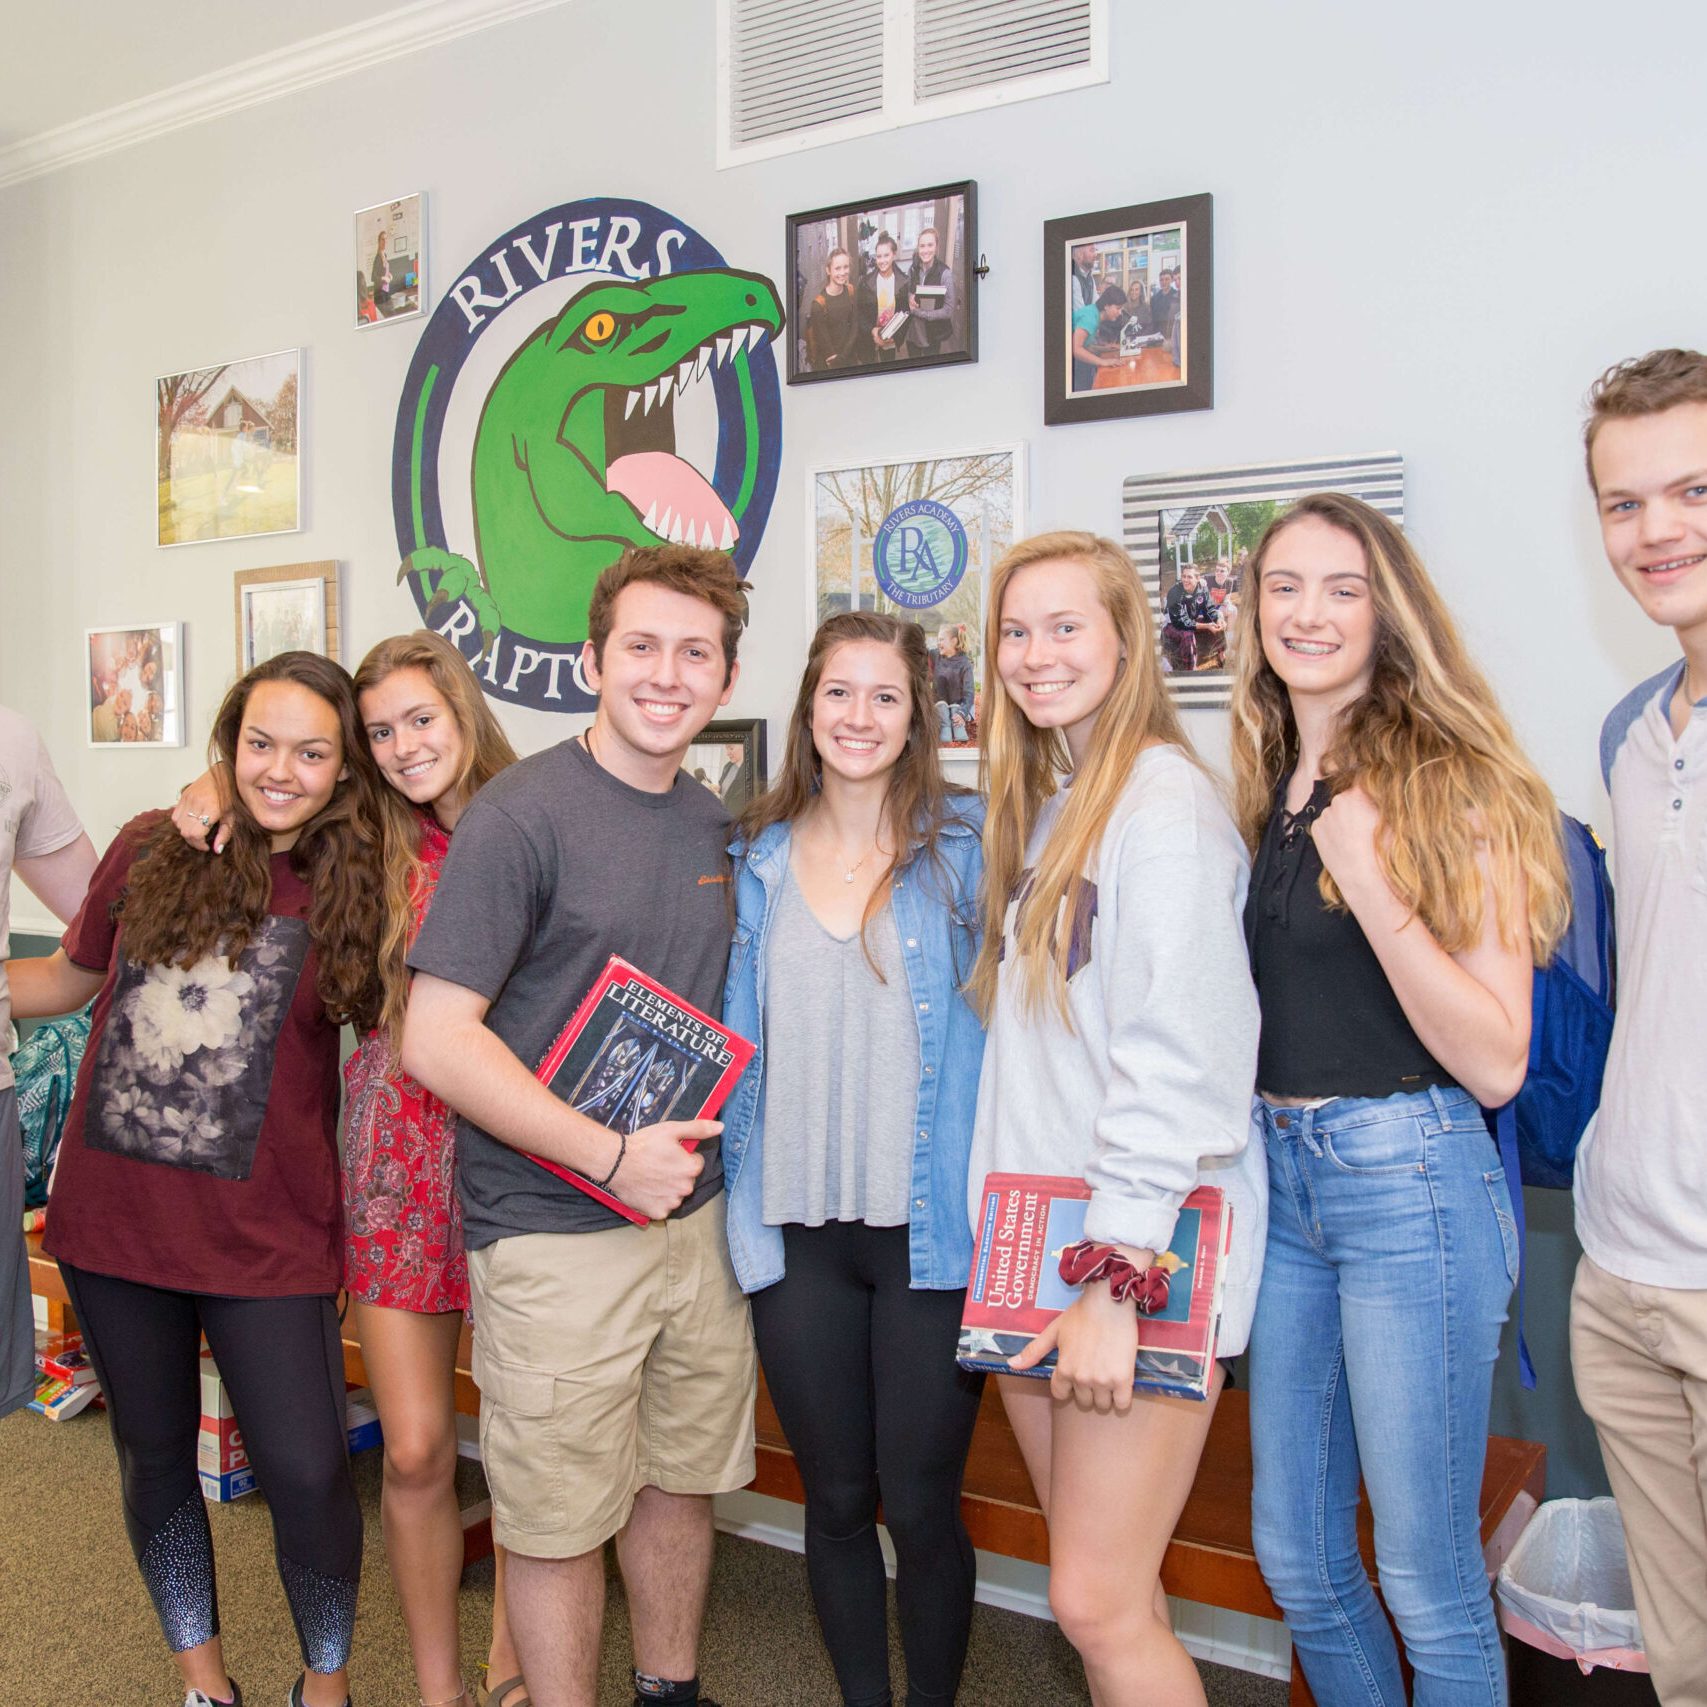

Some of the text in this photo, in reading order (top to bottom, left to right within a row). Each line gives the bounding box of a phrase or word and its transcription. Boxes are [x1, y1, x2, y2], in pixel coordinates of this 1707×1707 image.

[449, 215, 687, 335] RIVERS
[884, 504, 960, 533] RIVERS ACADEMY
[887, 580, 953, 605] THE TRIBUTARY
[606, 984, 731, 1067] LITERATURE
[627, 982, 727, 1047] ELEMENTS OF
[986, 1189, 1021, 1309] United States
[1005, 1191, 1039, 1310] Government
[1027, 1204, 1047, 1301] DEMOCRACY IN ACTION
